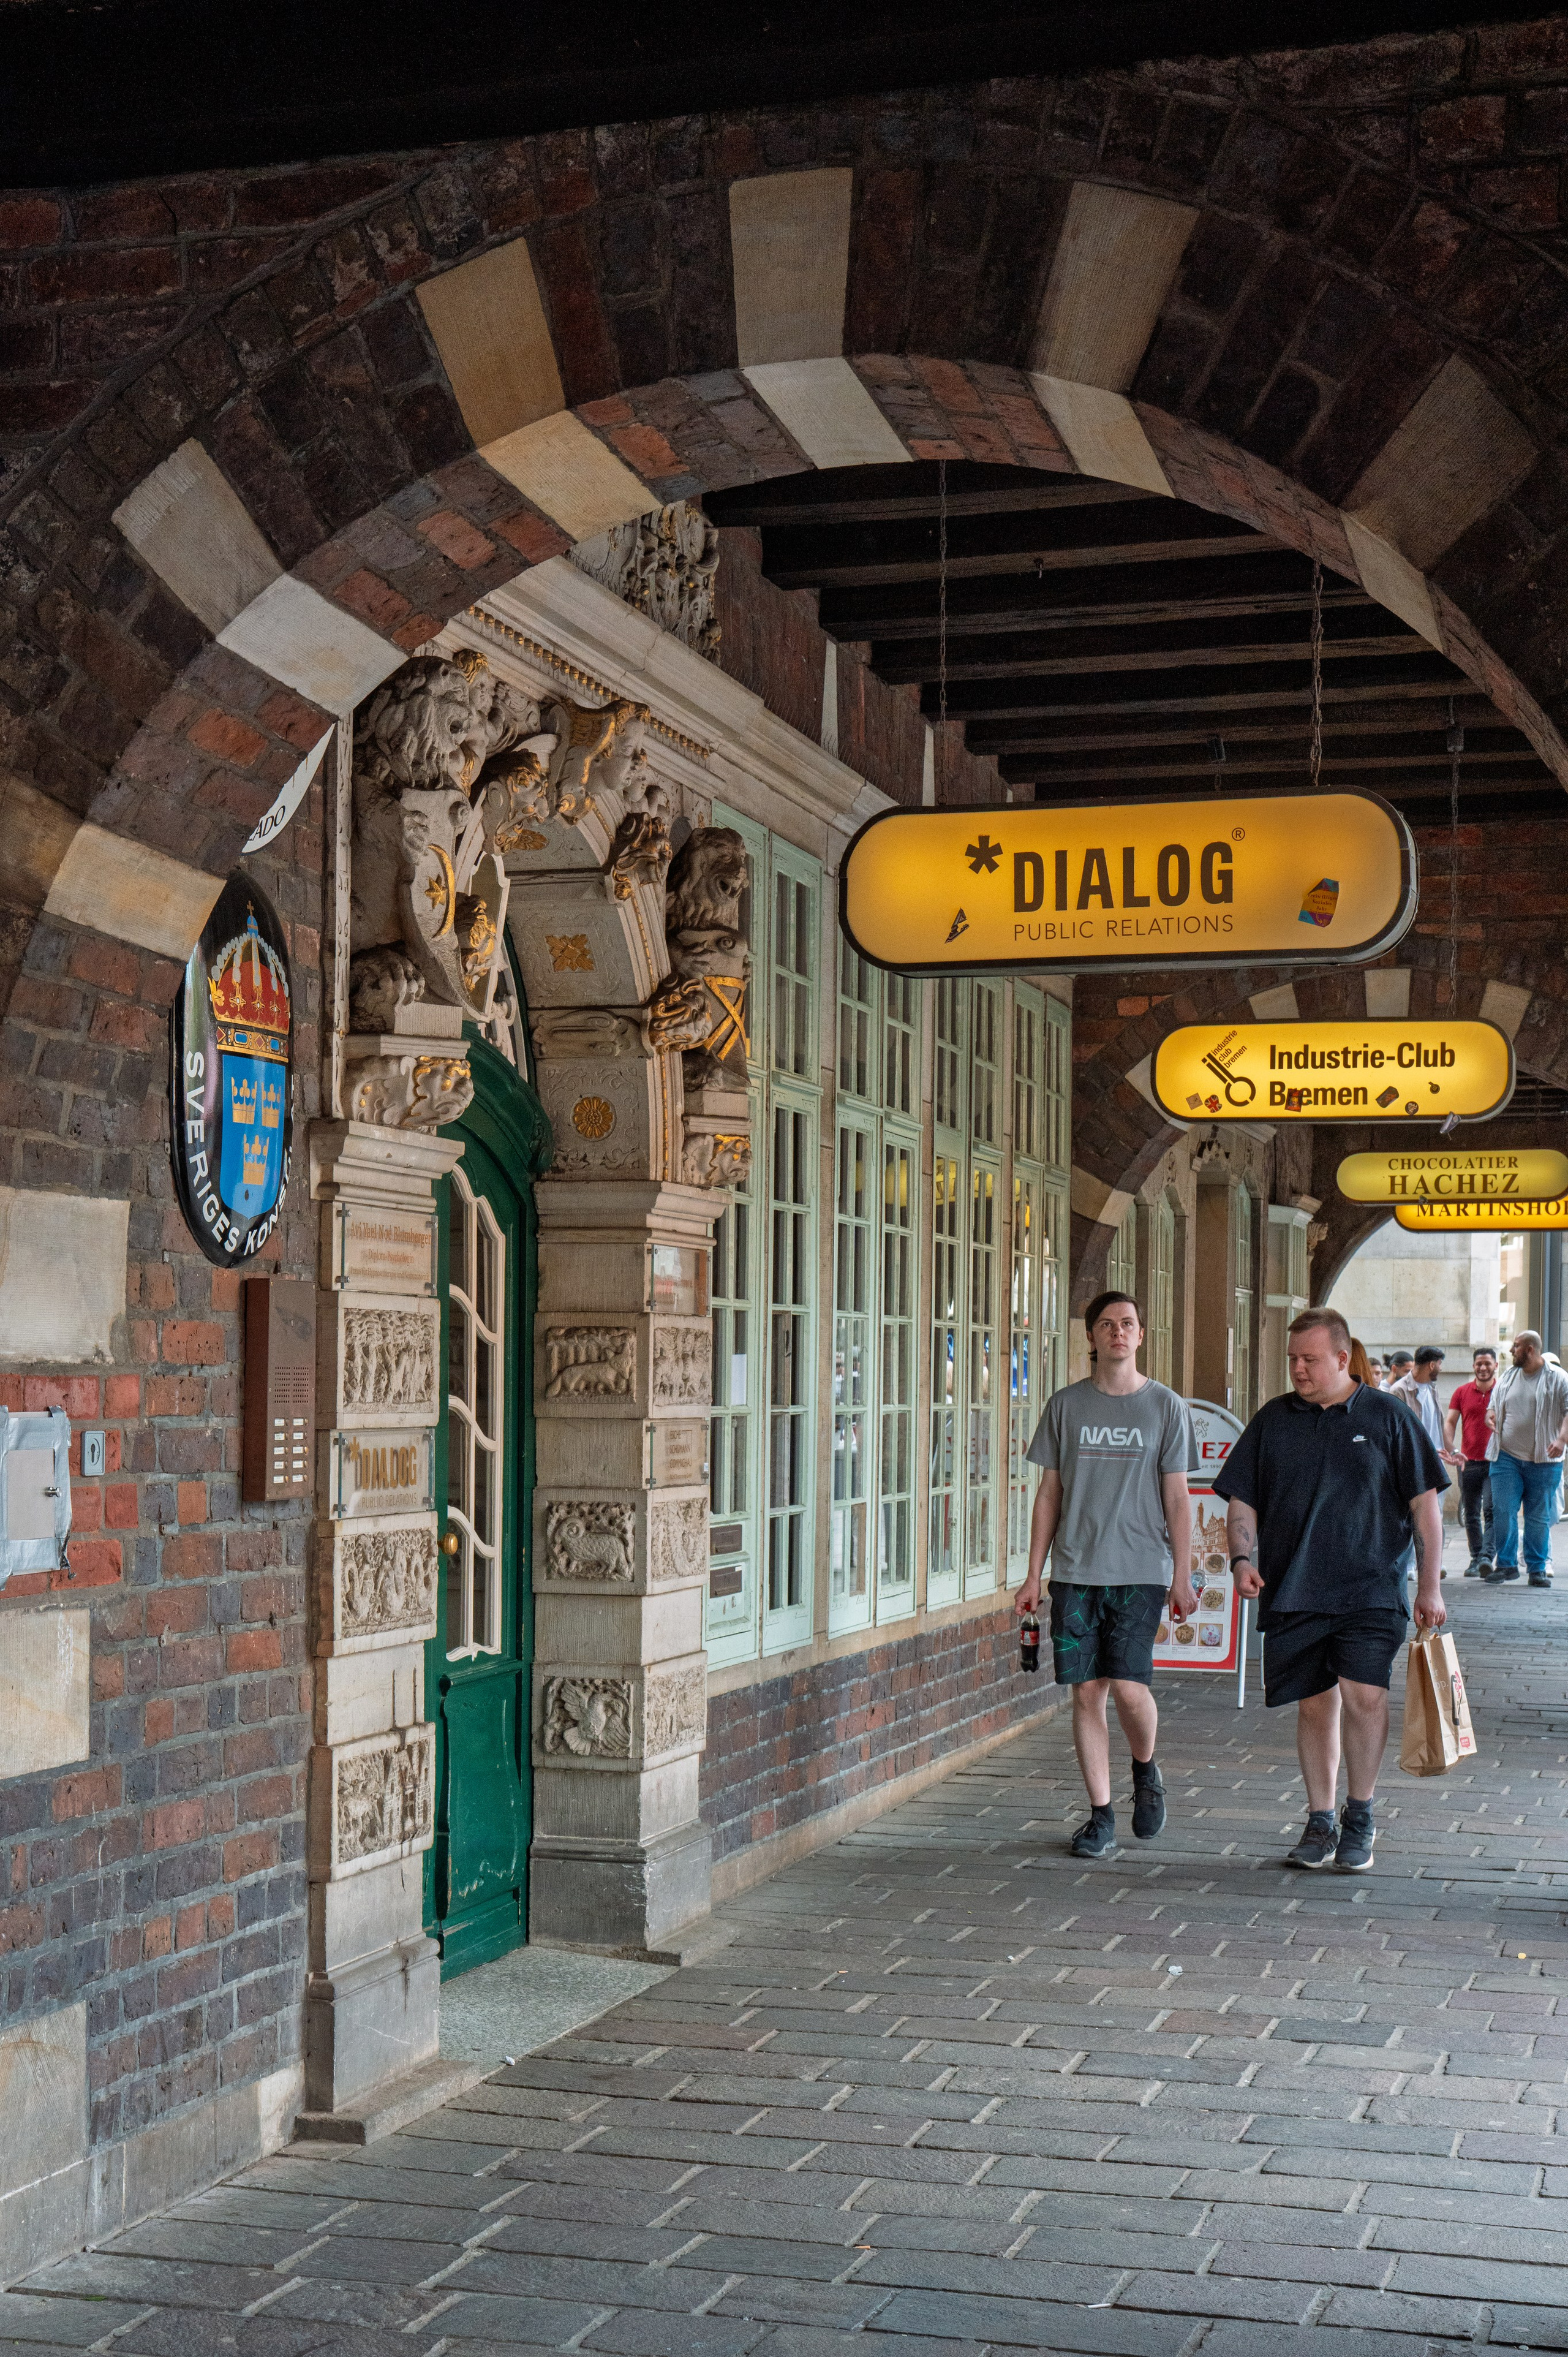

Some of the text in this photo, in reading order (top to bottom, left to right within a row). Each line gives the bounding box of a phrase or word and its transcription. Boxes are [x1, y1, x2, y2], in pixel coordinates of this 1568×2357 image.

[248, 805, 286, 842] ADO
[1014, 914, 1234, 941] PUBLIC RELATIONS
[1211, 1029, 1237, 1056] industrie
[1218, 1048, 1232, 1062] club
[1223, 1045, 1247, 1069] bremen
[1270, 1042, 1455, 1070] Industrie-Club
[1270, 1081, 1368, 1107] Bemen
[186, 1051, 240, 1253] SVERIGES
[1388, 1156, 1519, 1170] CHOCOLATIER
[1388, 1173, 1520, 1195] HACHEZ
[1079, 1426, 1144, 1447] NASA
[1197, 1442, 1232, 1460] EZ
[361, 1493, 417, 1508] PUBLIC RELATIONS
